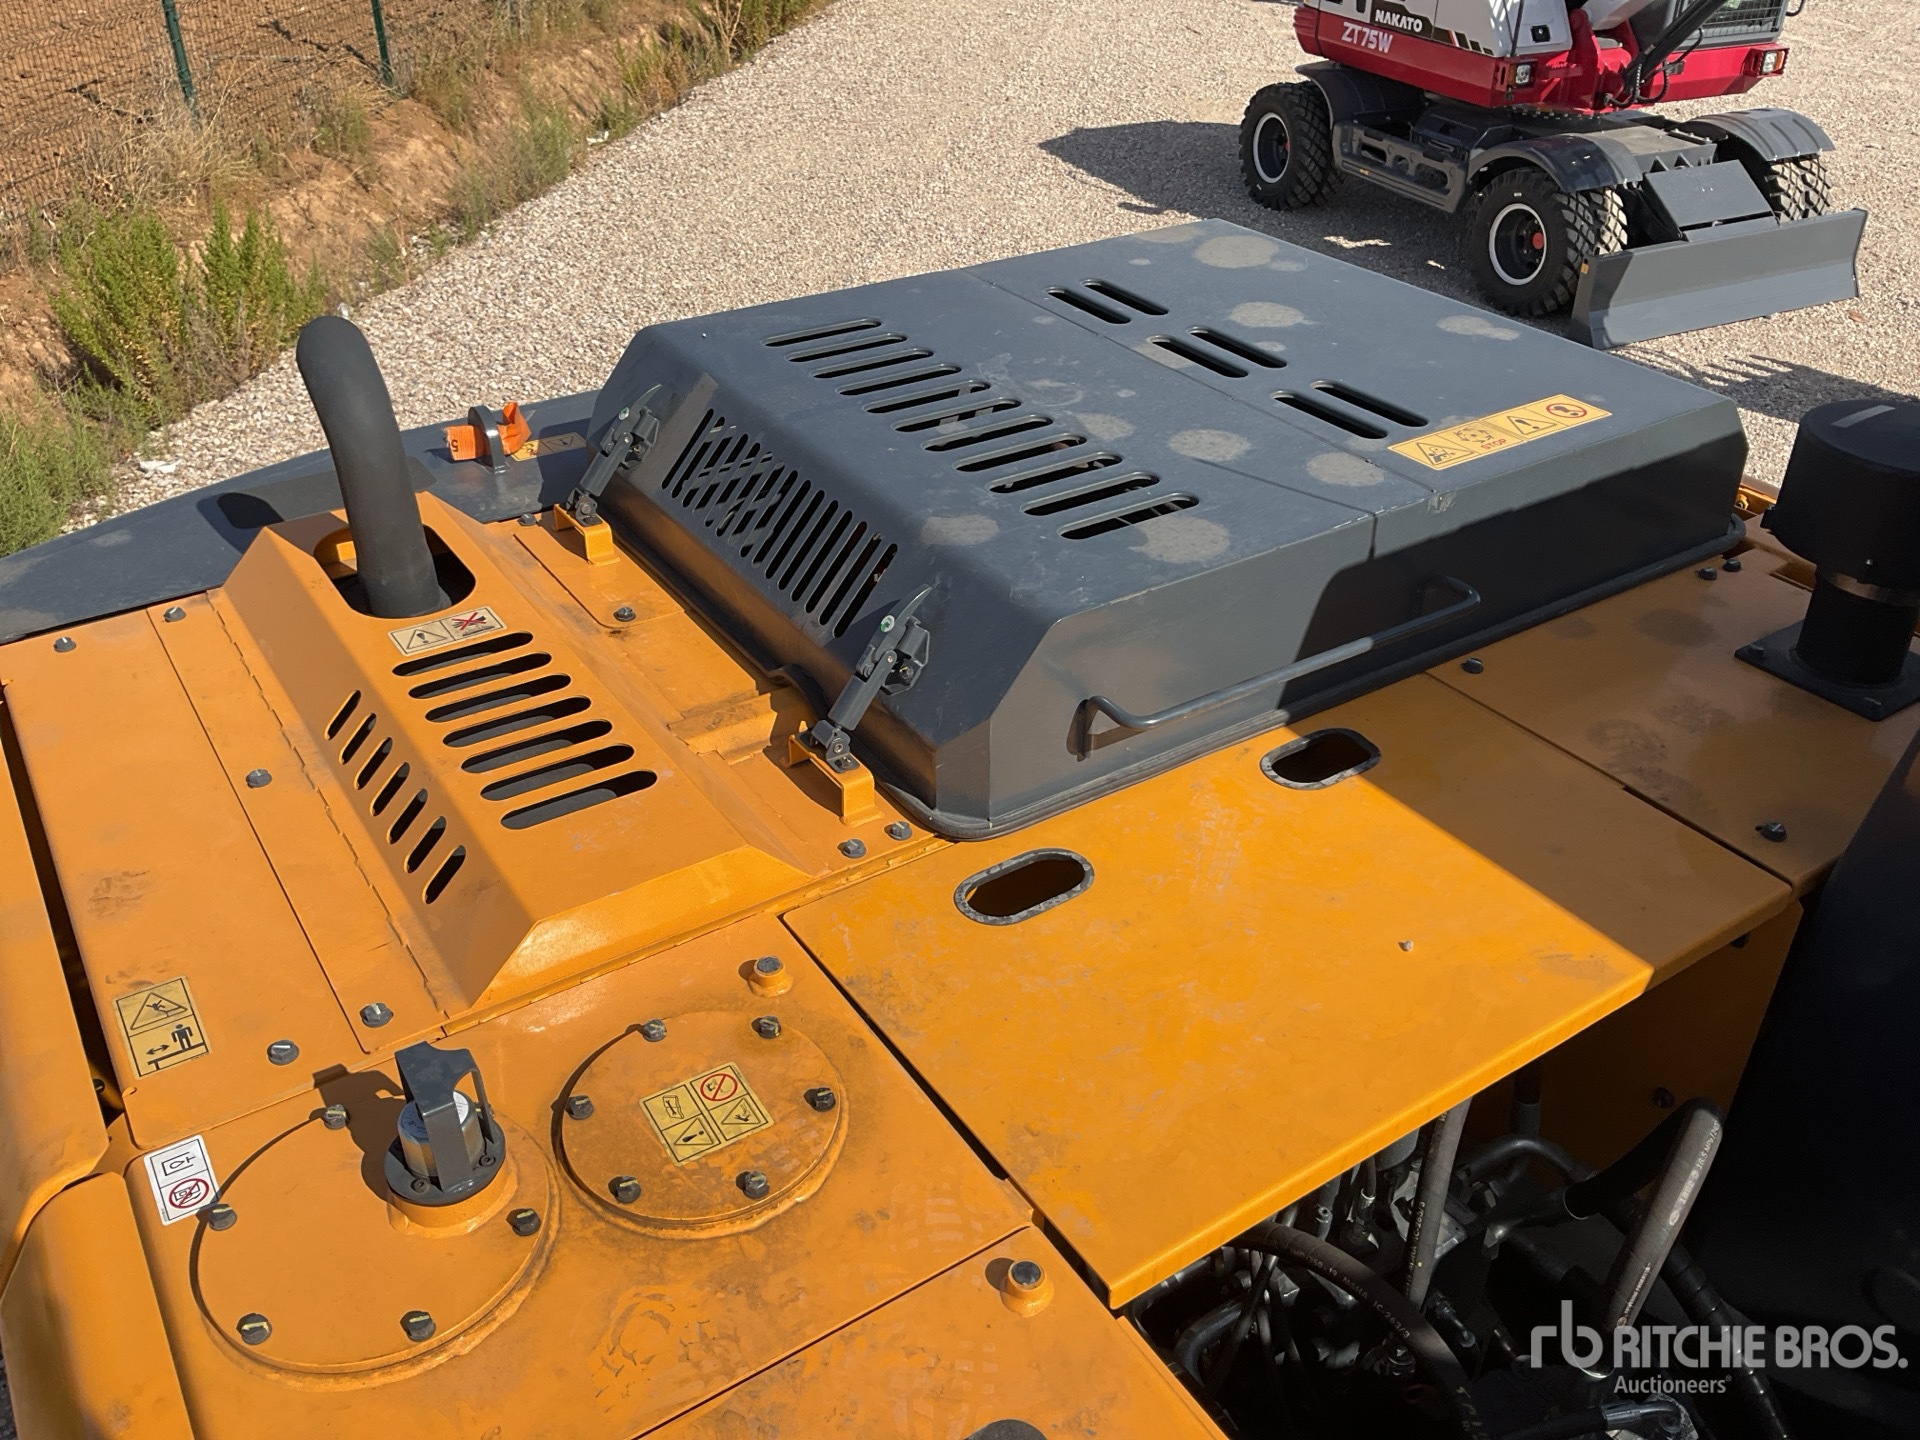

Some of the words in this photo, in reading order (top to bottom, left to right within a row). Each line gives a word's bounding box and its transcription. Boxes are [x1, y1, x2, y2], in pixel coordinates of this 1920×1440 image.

[1375, 9, 1423, 33] NAKATO
[1341, 21, 1393, 54] ZT75W
[1481, 439, 1507, 449] STOP
